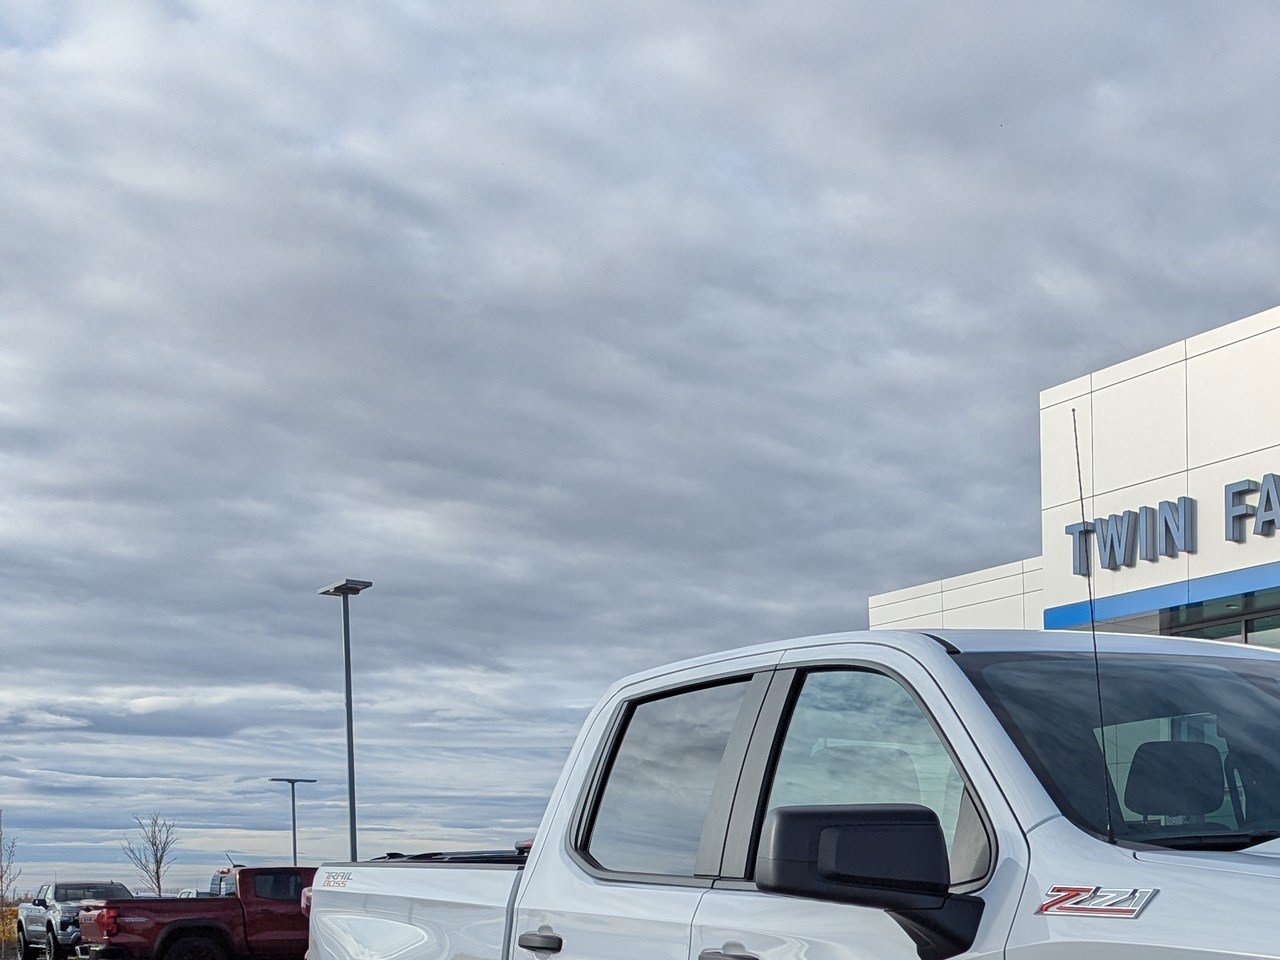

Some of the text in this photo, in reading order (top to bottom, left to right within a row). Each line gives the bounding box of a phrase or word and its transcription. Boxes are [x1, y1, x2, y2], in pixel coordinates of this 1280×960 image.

[1065, 496, 1197, 576] TWIN
[322, 880, 348, 888] BOSS
[324, 871, 354, 881] TRAIL
[1033, 885, 1160, 919] Z71
